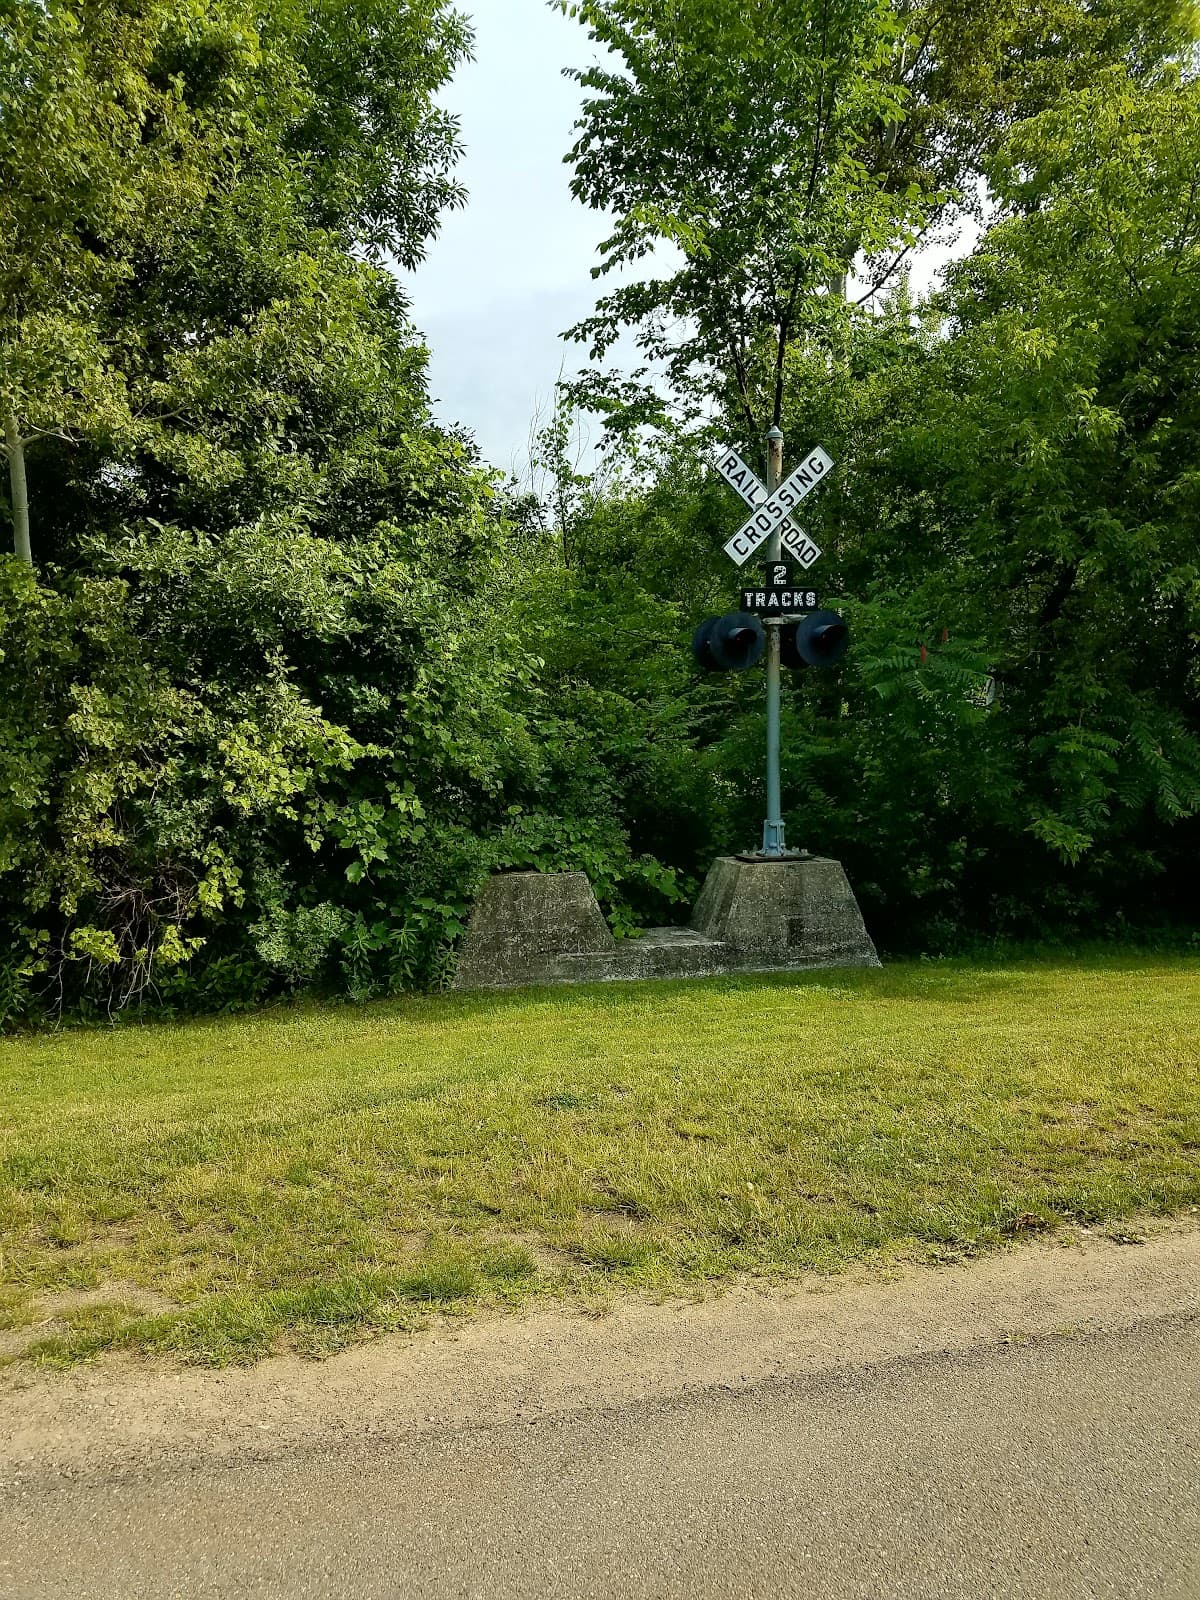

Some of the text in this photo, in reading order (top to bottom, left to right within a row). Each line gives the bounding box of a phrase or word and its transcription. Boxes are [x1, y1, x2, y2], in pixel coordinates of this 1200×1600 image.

[721, 456, 817, 564] RAIL ROAD
[732, 457, 825, 556] CROSSING
[744, 591, 816, 607] TRACKS
[773, 565, 787, 585] 2
